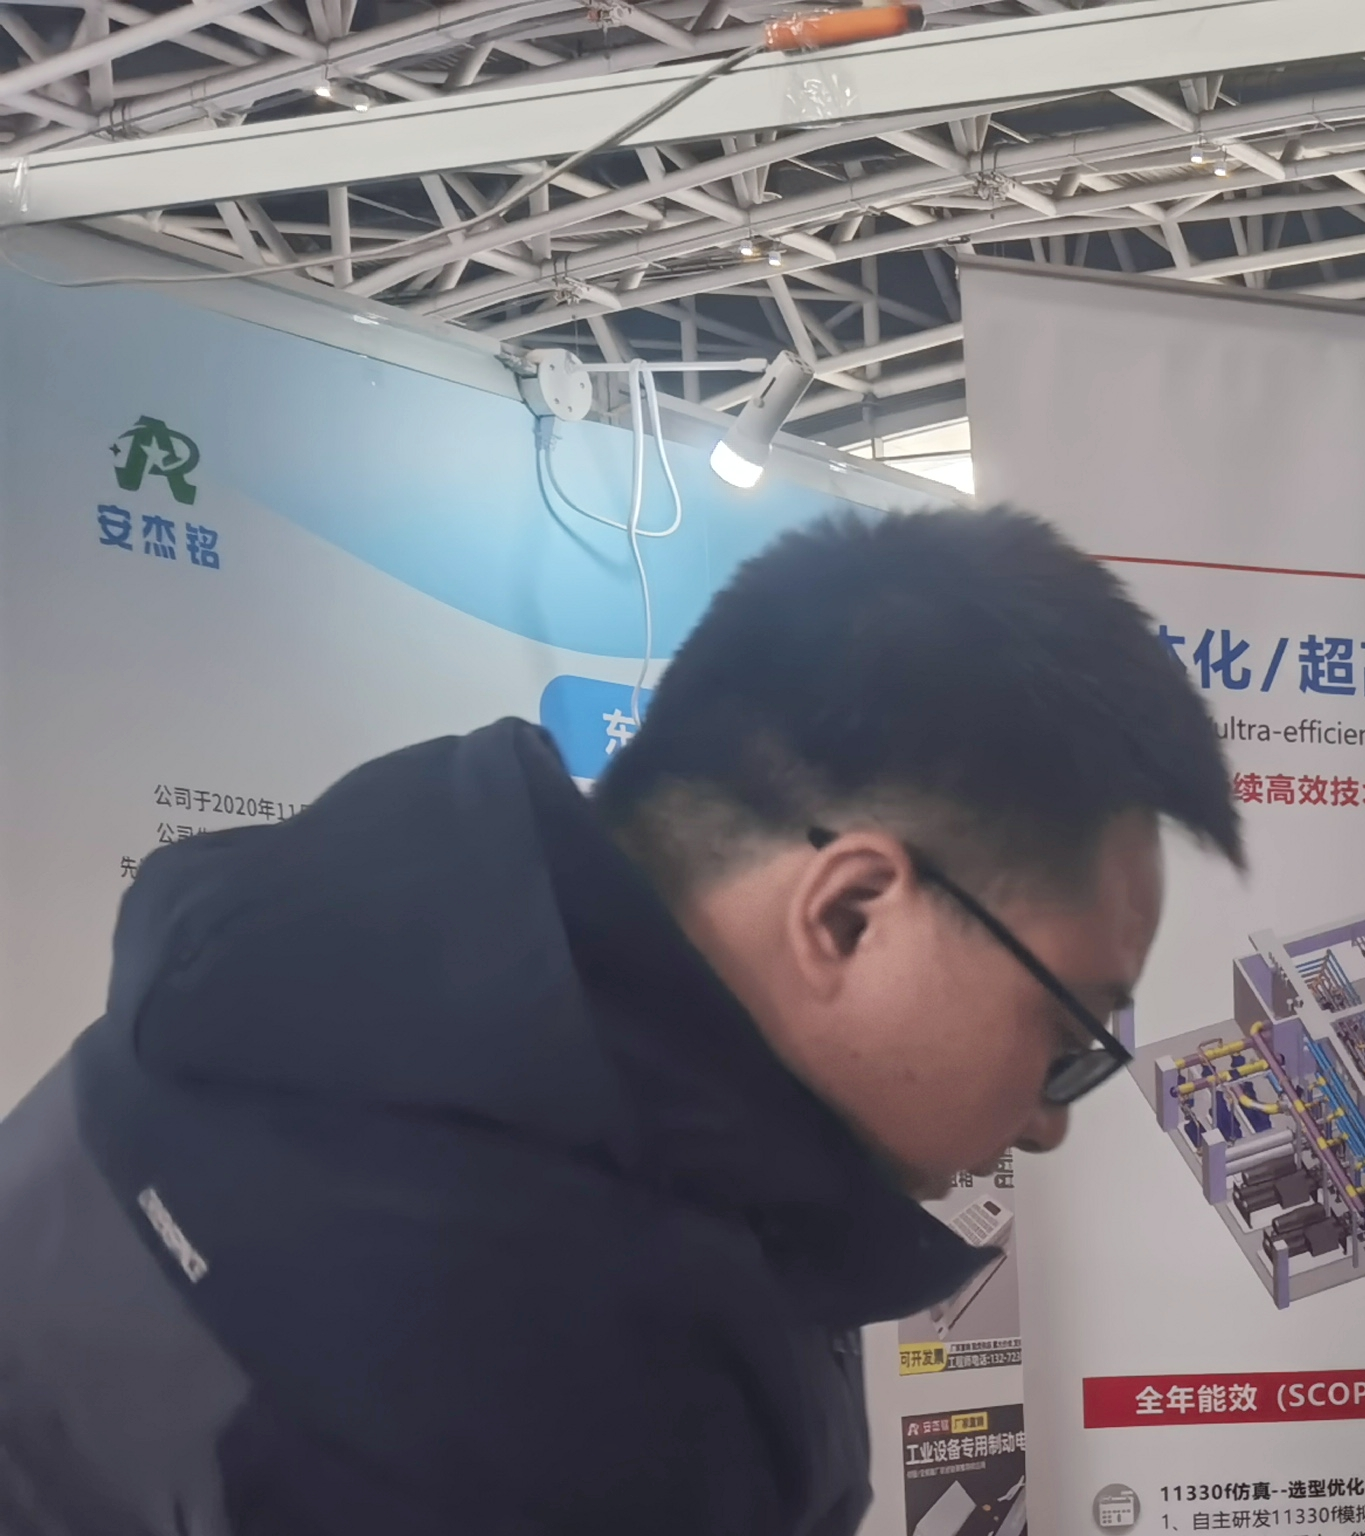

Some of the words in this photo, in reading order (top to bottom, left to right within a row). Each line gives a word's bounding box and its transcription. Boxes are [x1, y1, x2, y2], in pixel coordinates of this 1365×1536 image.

[97, 504, 221, 570] 安杰铭
[154, 784, 312, 822] 公司于2020年11
[157, 822, 211, 845] 公司
[120, 855, 141, 879] 先
[899, 1348, 945, 1369] 可开发票
[906, 1430, 1027, 1466] 工业设备专用制动电
[1160, 1476, 1365, 1503] 11330f仿真--选型优化
